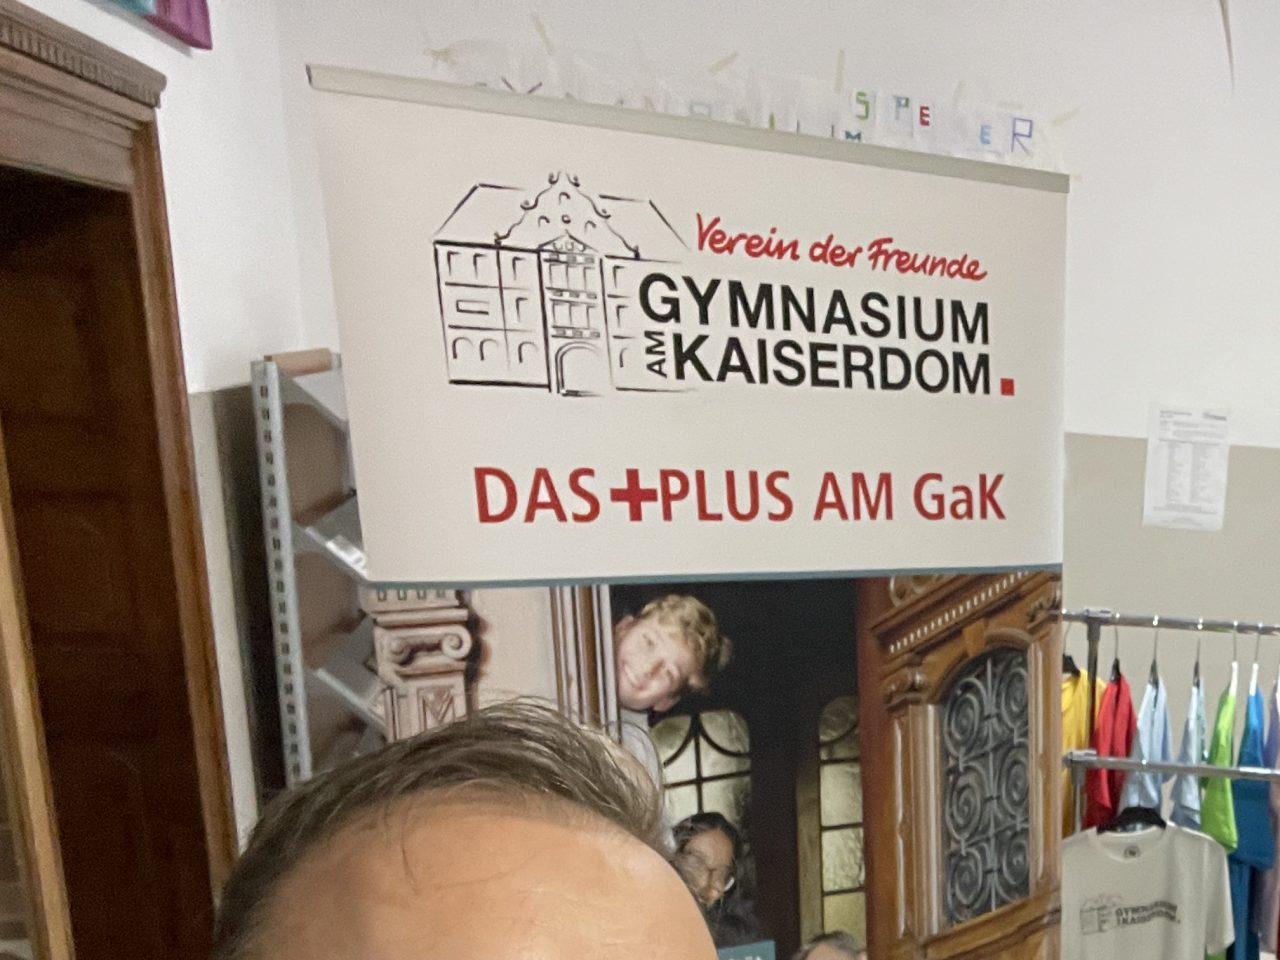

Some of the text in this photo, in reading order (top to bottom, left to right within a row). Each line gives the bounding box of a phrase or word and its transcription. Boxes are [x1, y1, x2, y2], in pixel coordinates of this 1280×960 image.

[696, 213, 988, 282] Verein der Freunde
[639, 273, 989, 345] GYMNASIUM
[645, 331, 667, 378] AM
[814, 472, 893, 520] AM
[914, 473, 1006, 520] GaK
